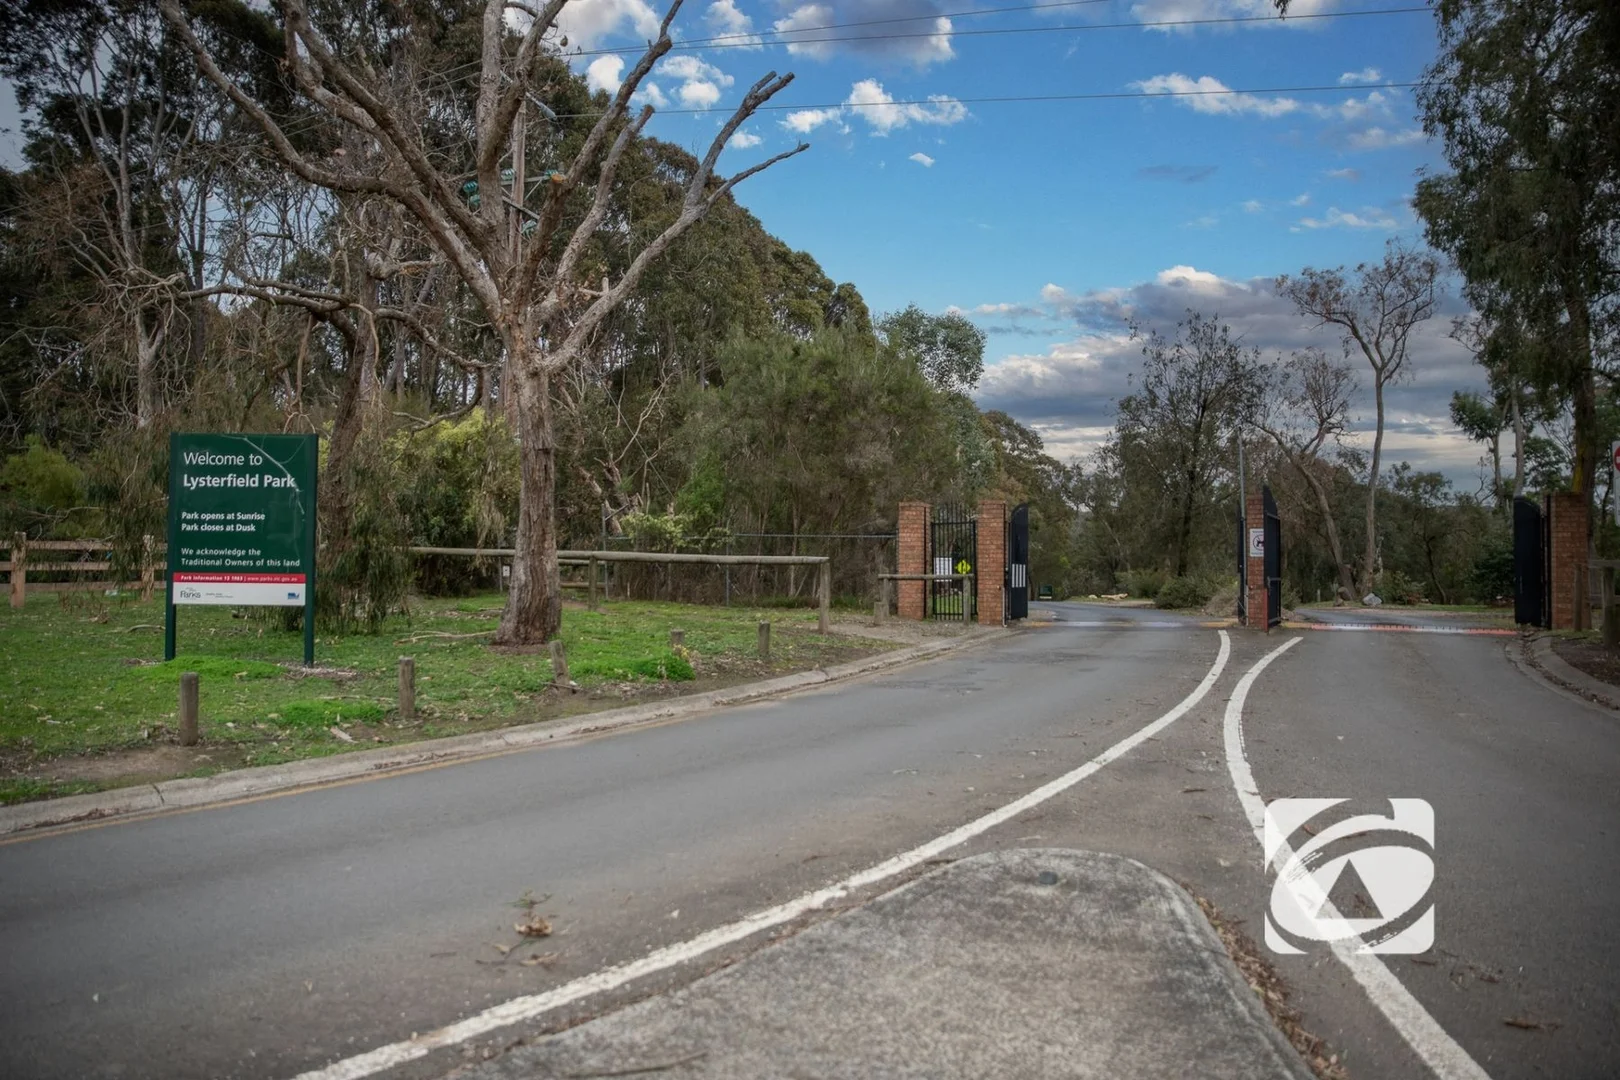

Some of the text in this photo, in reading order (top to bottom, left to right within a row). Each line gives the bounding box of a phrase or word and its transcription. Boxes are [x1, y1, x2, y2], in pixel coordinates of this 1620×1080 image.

[184, 452, 263, 466] Welcome to
[183, 473, 296, 491] Lysterfield Park
[181, 511, 266, 522] Park opens at Sunrise
[181, 523, 256, 532] Park closes at Dusk
[181, 548, 261, 558] We acknowledge the
[181, 559, 301, 568] Traditional Owners of this land
